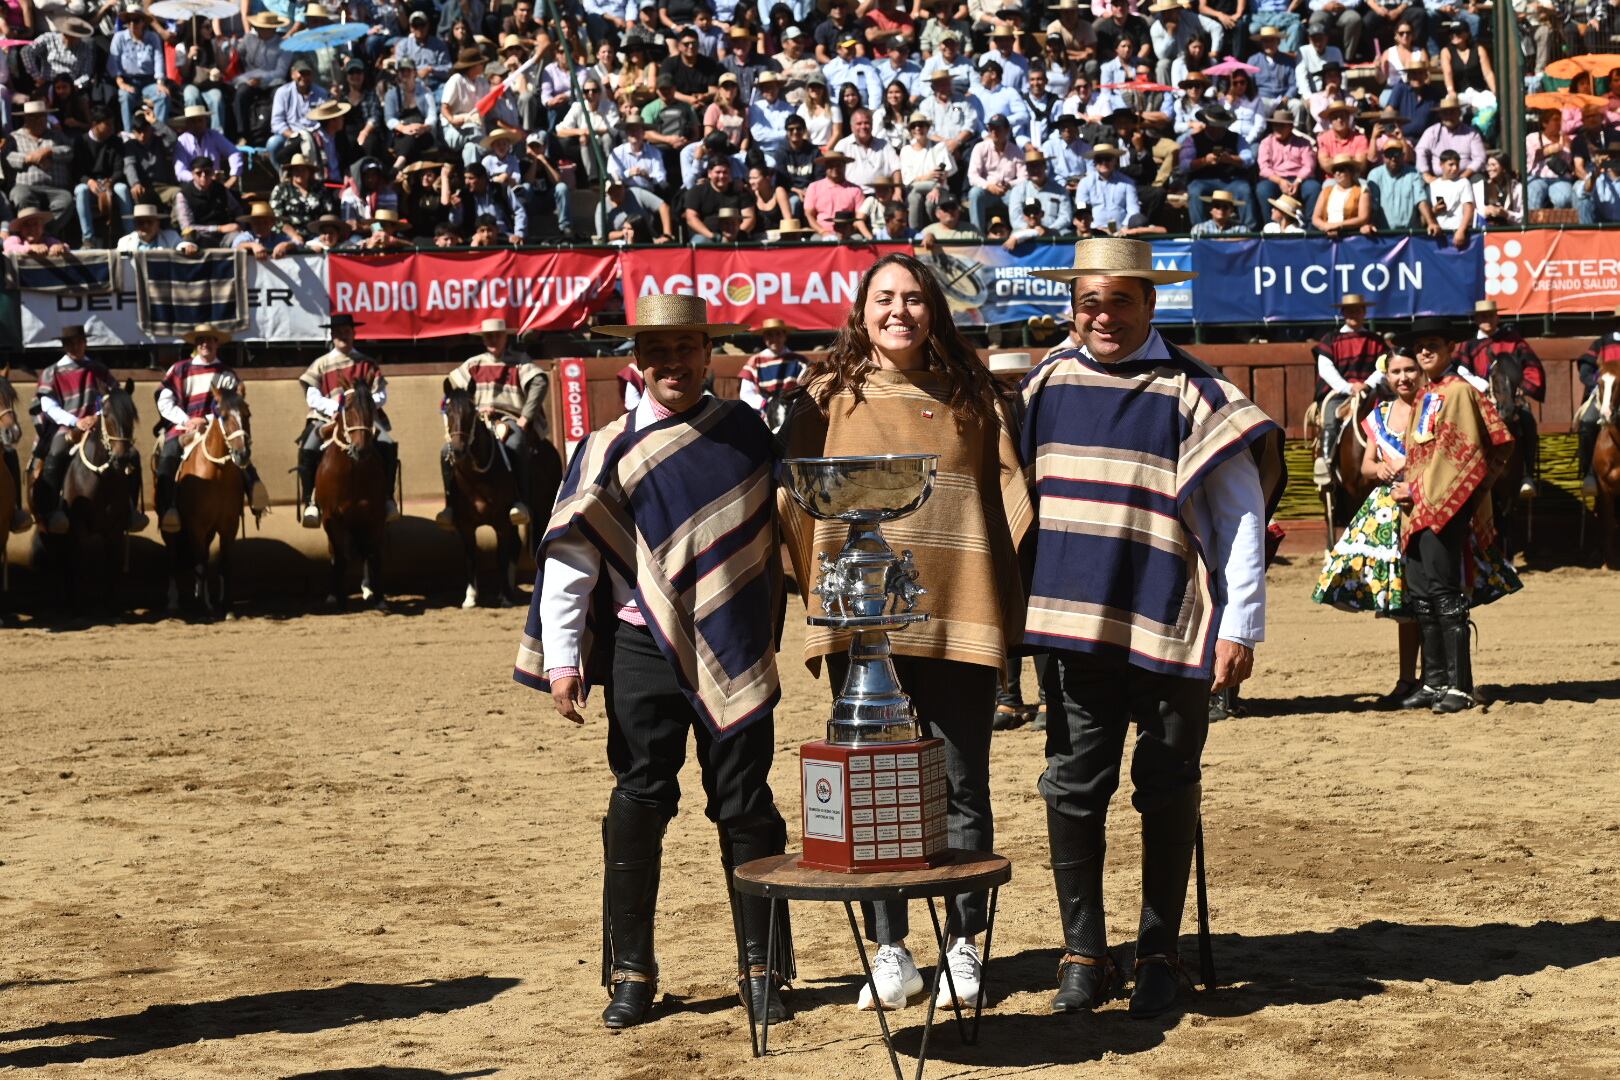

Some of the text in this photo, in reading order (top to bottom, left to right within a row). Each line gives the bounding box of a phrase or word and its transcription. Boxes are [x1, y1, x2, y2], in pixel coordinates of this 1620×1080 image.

[639, 271, 866, 307] AGROPLAN
[995, 279, 1072, 297] OFICIA
[1254, 261, 1423, 295] PICTON
[1583, 277, 1618, 291] SALUD
[56, 288, 294, 312] DEFER
[336, 281, 418, 312] RADIO
[568, 381, 584, 438] RODEO
